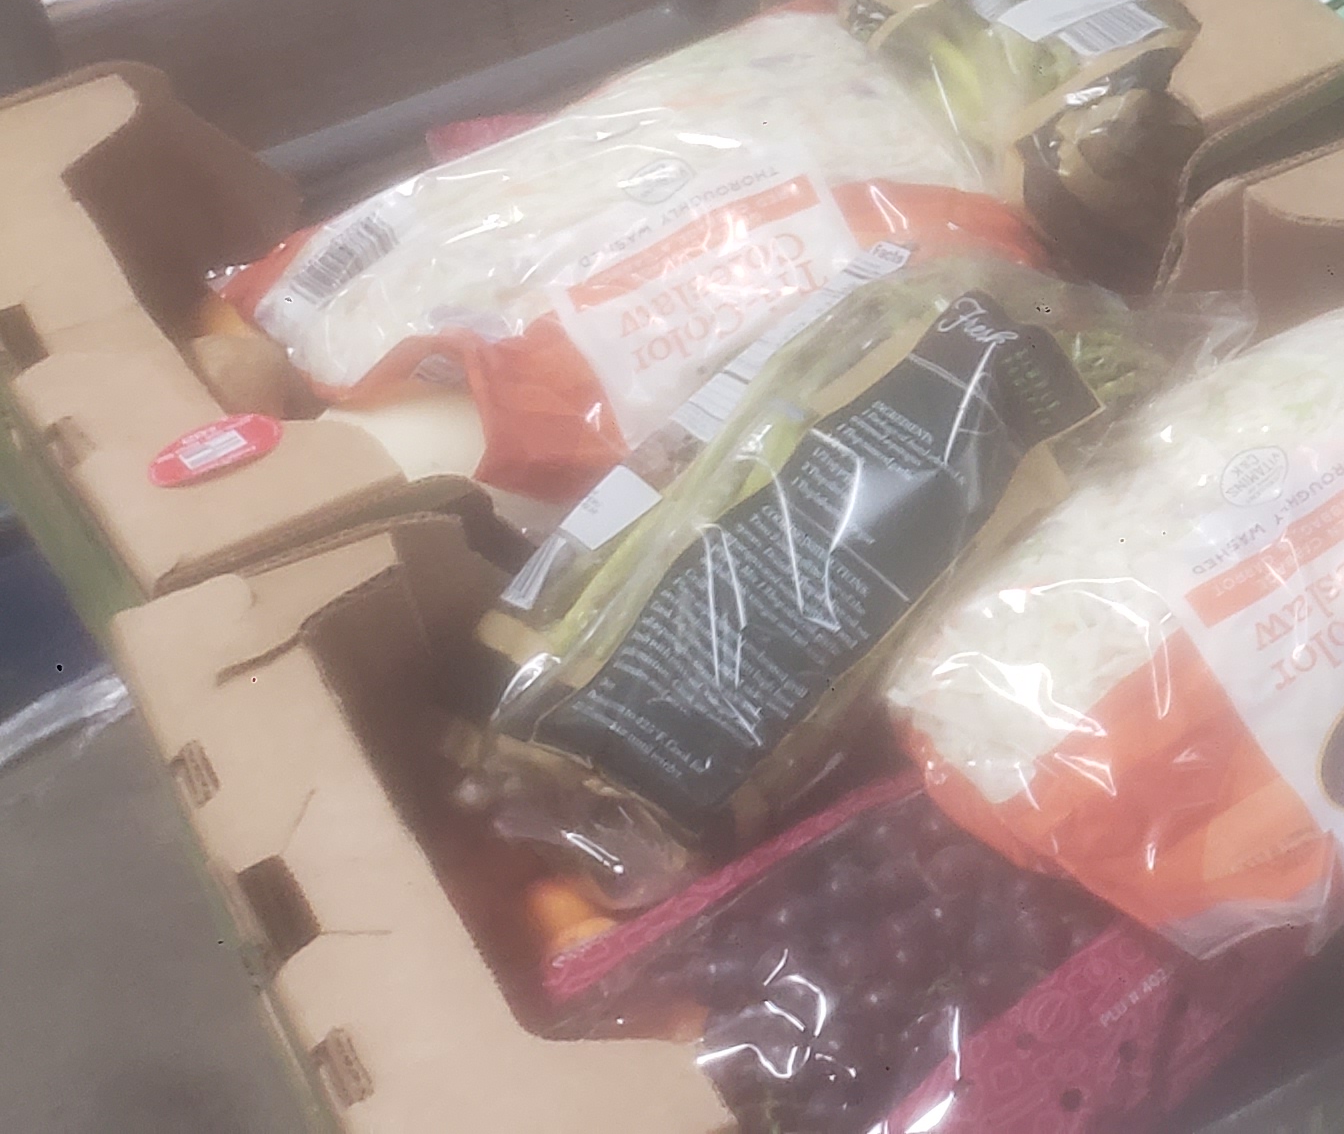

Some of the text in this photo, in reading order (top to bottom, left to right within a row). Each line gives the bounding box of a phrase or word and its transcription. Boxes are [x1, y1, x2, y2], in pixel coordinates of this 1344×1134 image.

[662, 166, 778, 225] THOROUGHLY
[1224, 451, 1282, 498] VITAMINS
[1192, 522, 1266, 576] WASHED
